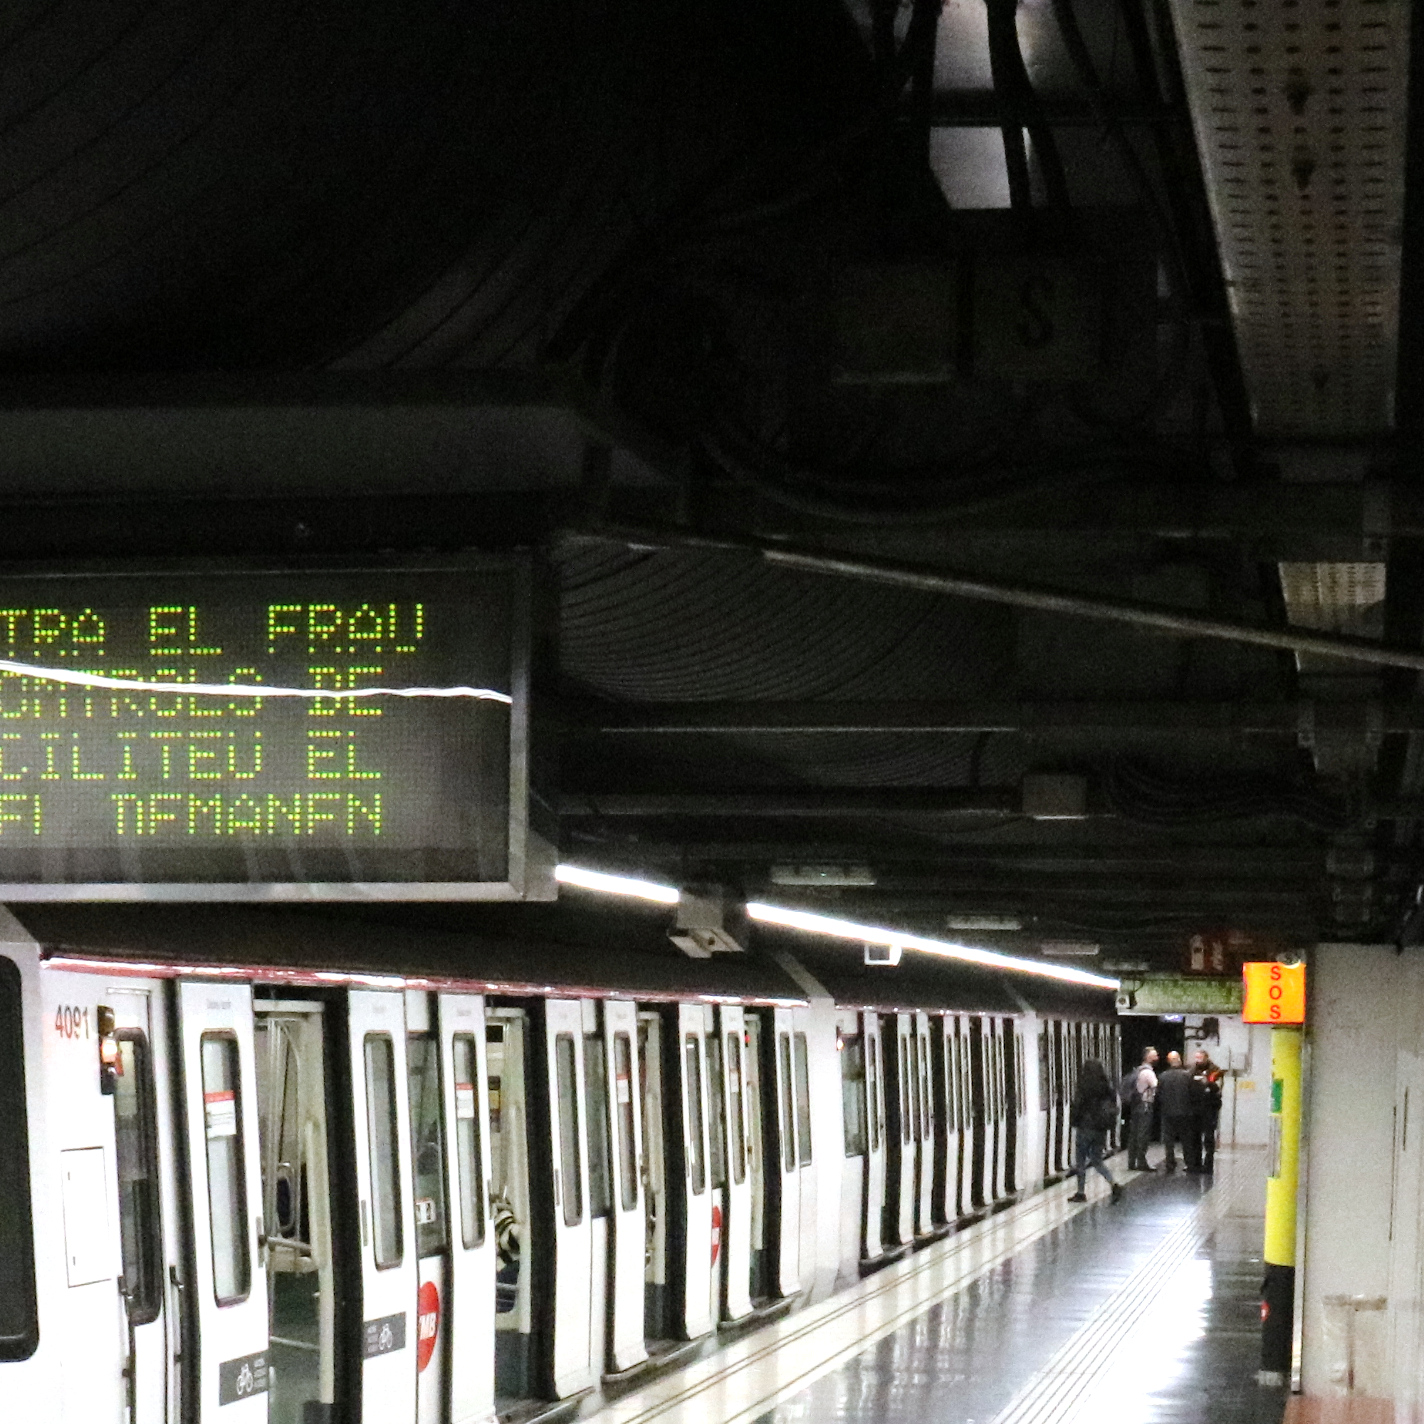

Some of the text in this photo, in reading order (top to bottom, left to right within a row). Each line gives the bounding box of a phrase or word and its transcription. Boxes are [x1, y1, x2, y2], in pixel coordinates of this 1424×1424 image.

[149, 605, 224, 656] EL
[268, 602, 425, 654] FRAU
[306, 729, 383, 780] EL
[55, 1004, 89, 1040] 4091
